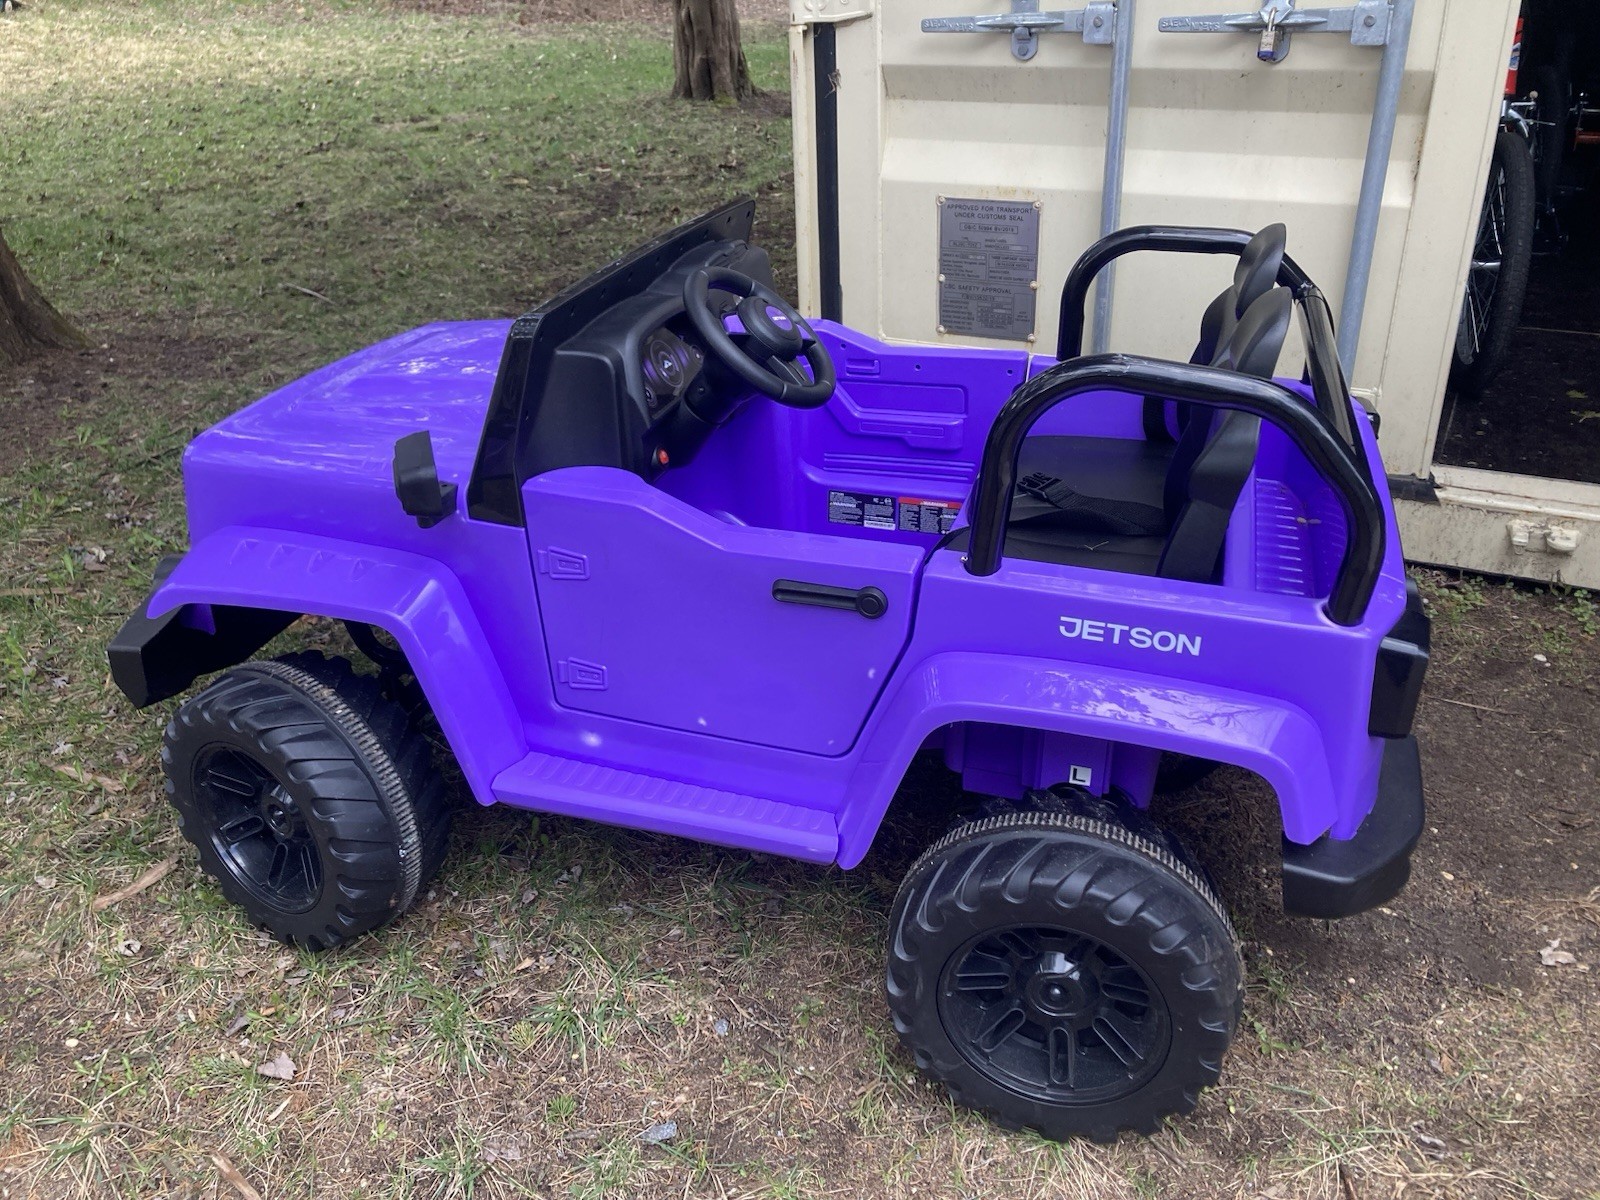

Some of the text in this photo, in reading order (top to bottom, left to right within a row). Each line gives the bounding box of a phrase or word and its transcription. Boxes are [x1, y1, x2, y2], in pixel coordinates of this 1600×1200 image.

[947, 204, 979, 212] APPROVED
[996, 206, 1033, 214] TRANSPORT
[977, 213, 1007, 221] CUSTOMS
[981, 286, 1012, 295] APPROVAL
[1059, 616, 1202, 656] JETSON
[1072, 767, 1086, 783] L
